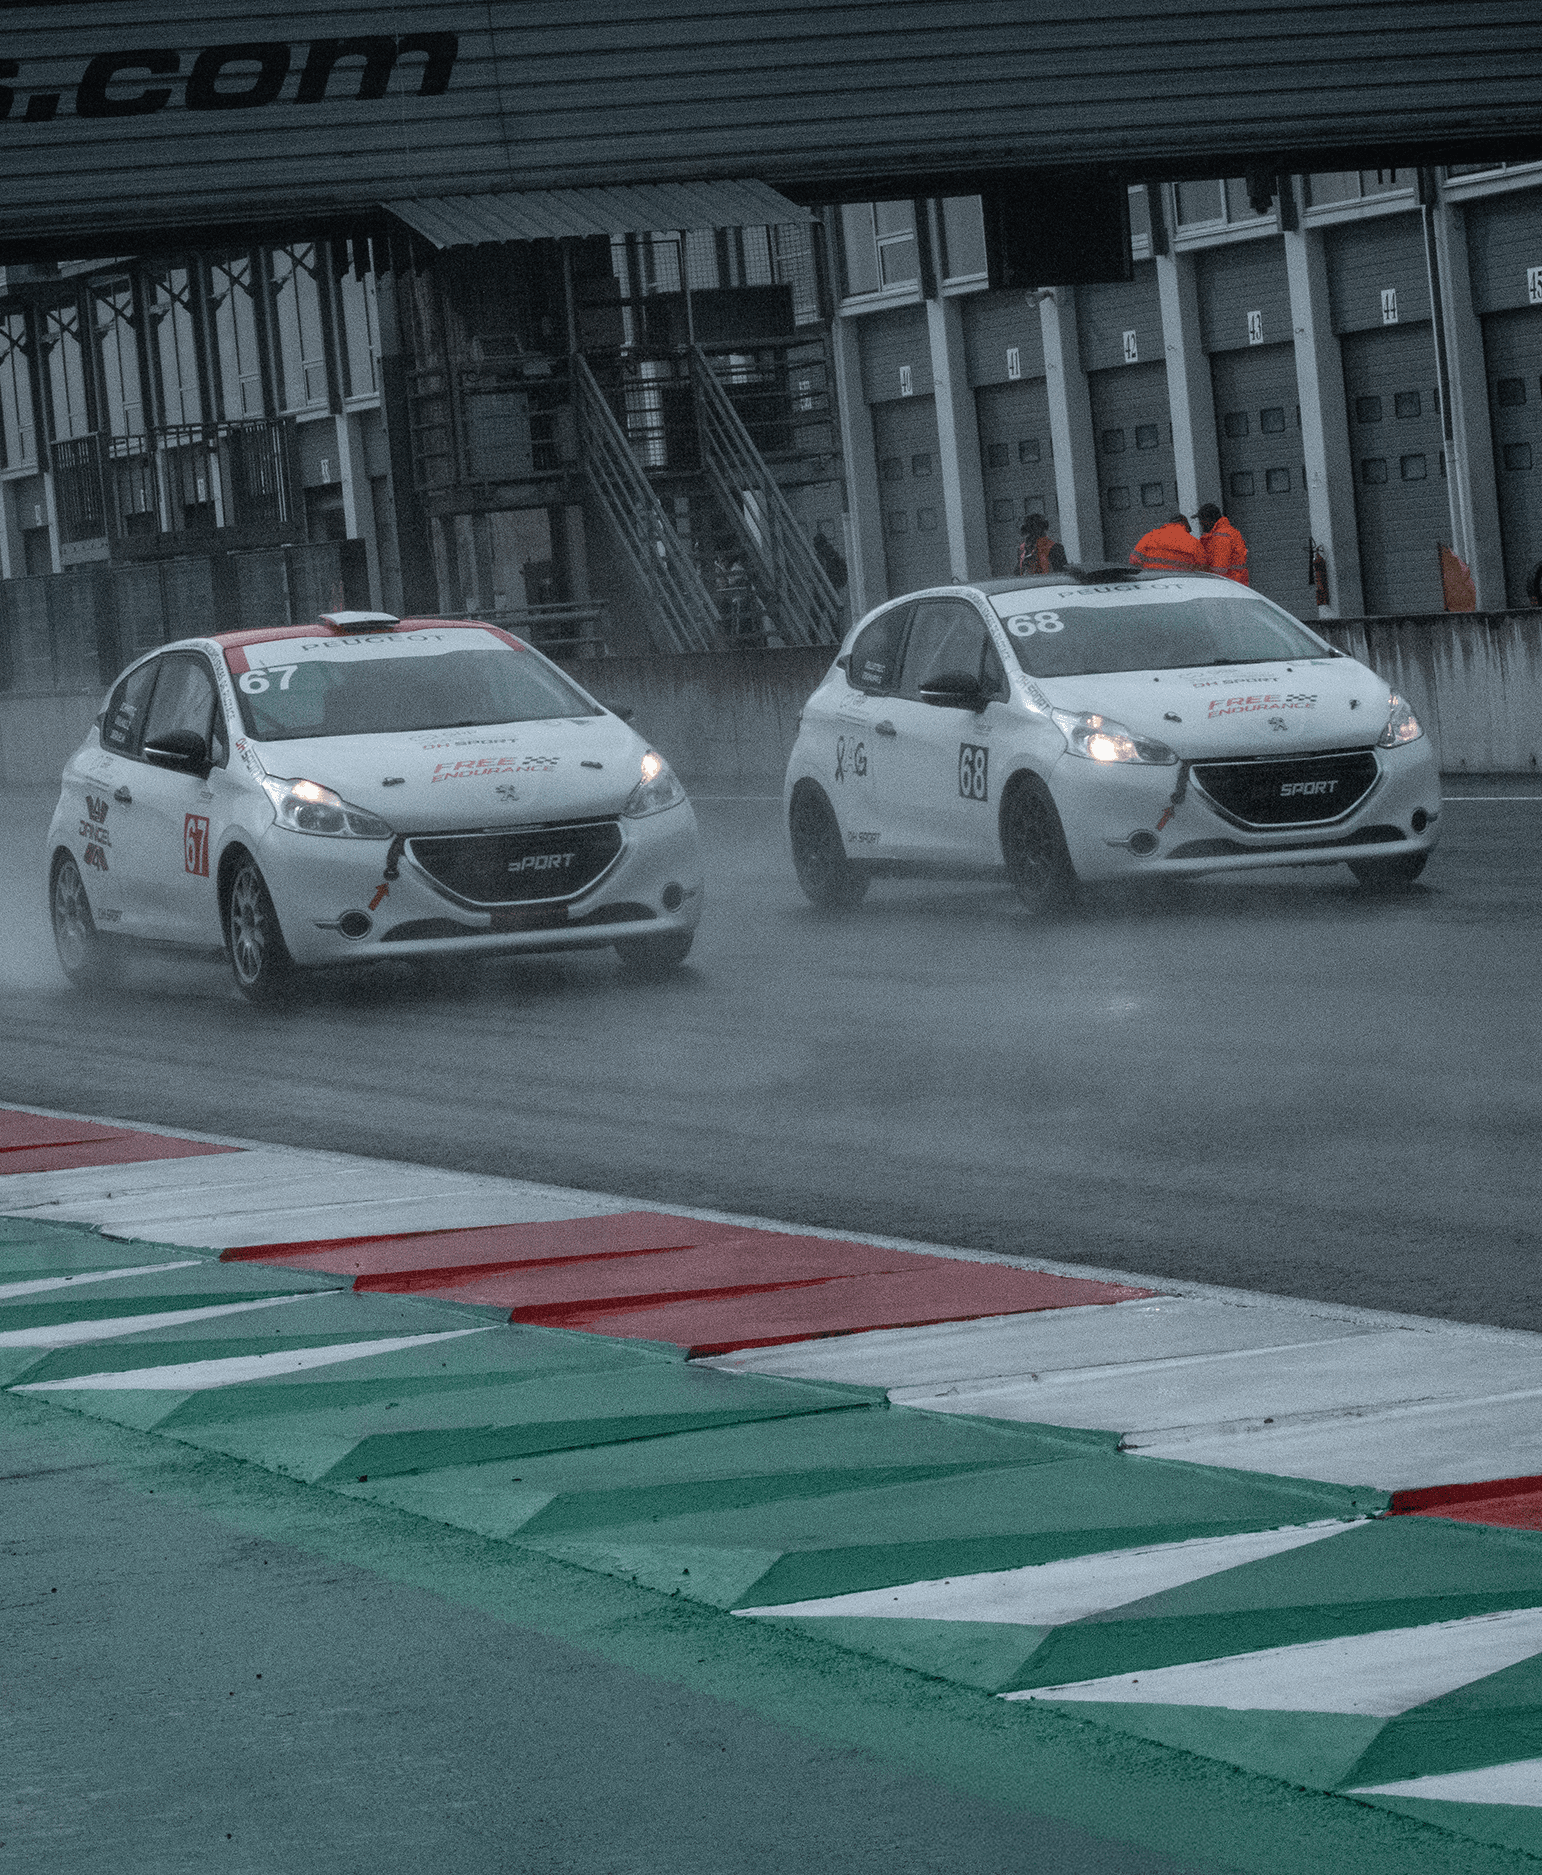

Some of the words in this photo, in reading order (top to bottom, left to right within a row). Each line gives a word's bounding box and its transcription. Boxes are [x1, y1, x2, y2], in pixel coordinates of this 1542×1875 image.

[0, 31, 459, 123] .com
[1530, 271, 1542, 299] 45
[1384, 292, 1396, 320] 44
[1250, 314, 1262, 340] 43
[1125, 333, 1137, 359] 42
[1009, 351, 1020, 376] 41
[1057, 583, 1185, 599] PEUGEOT
[1007, 611, 1065, 637] 68
[301, 634, 445, 652] PEUGEOT
[238, 665, 298, 695] 67
[1223, 677, 1280, 685] SPORT
[1207, 703, 1316, 720] ENDURANCE
[1208, 694, 1281, 711] FREE
[455, 738, 518, 747] SPORT
[431, 765, 555, 783] ENDURANCE
[434, 757, 518, 774] FREE
[961, 746, 985, 799] 68
[1280, 779, 1339, 797] SPORT
[186, 817, 208, 875] 67
